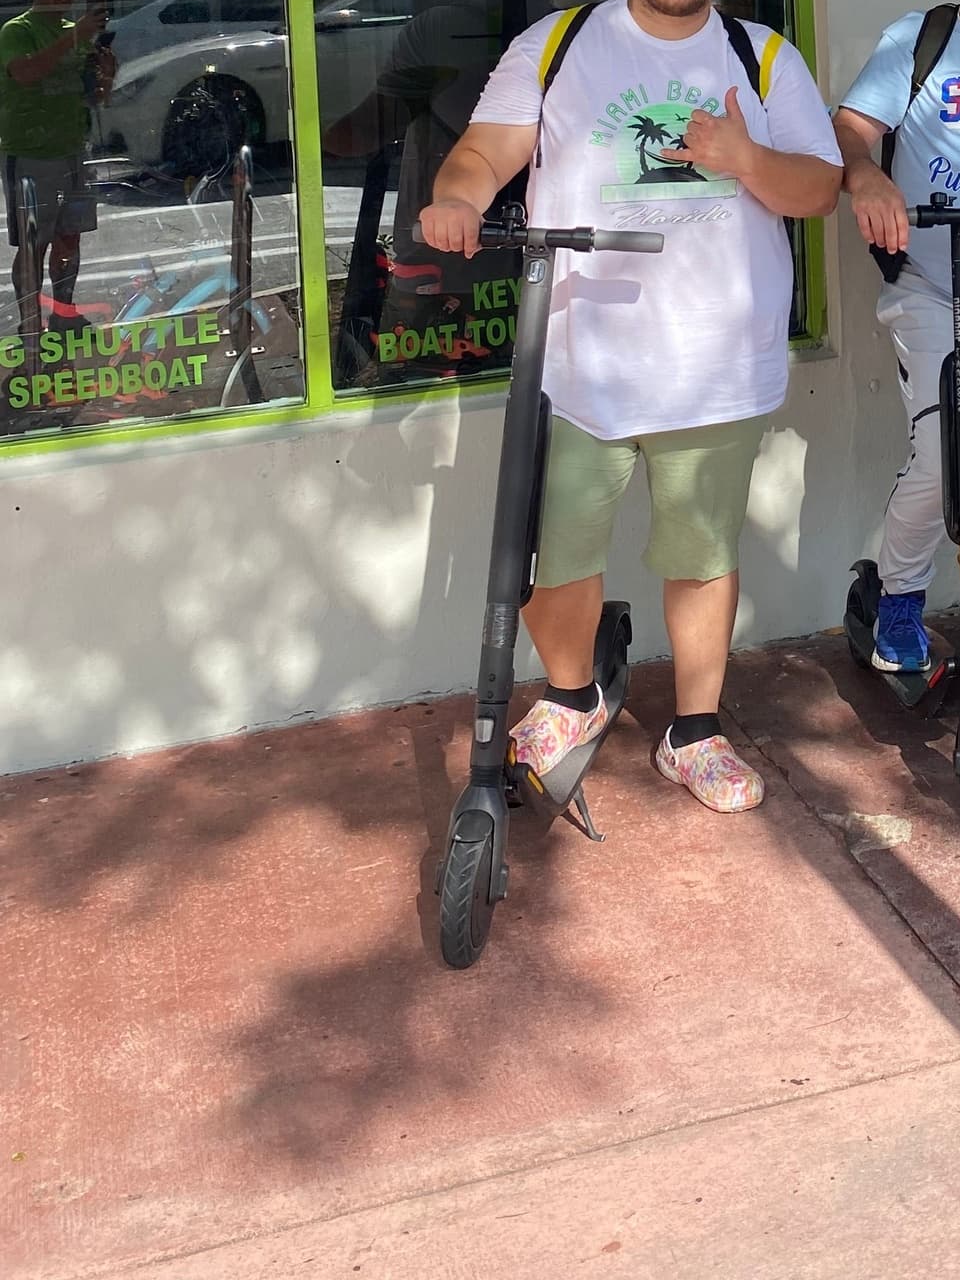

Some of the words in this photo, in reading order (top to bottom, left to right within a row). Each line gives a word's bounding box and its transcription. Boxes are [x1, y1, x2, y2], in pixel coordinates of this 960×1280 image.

[590, 83, 648, 147] MIAMI
[667, 80, 721, 115] BEA
[608, 204, 733, 228] Florida
[473, 277, 523, 311] KEY
[40, 312, 220, 365] SHUTTLE
[379, 323, 457, 362] BOAT
[469, 317, 519, 352] TOU
[8, 354, 208, 408] SPEEDBOAT
